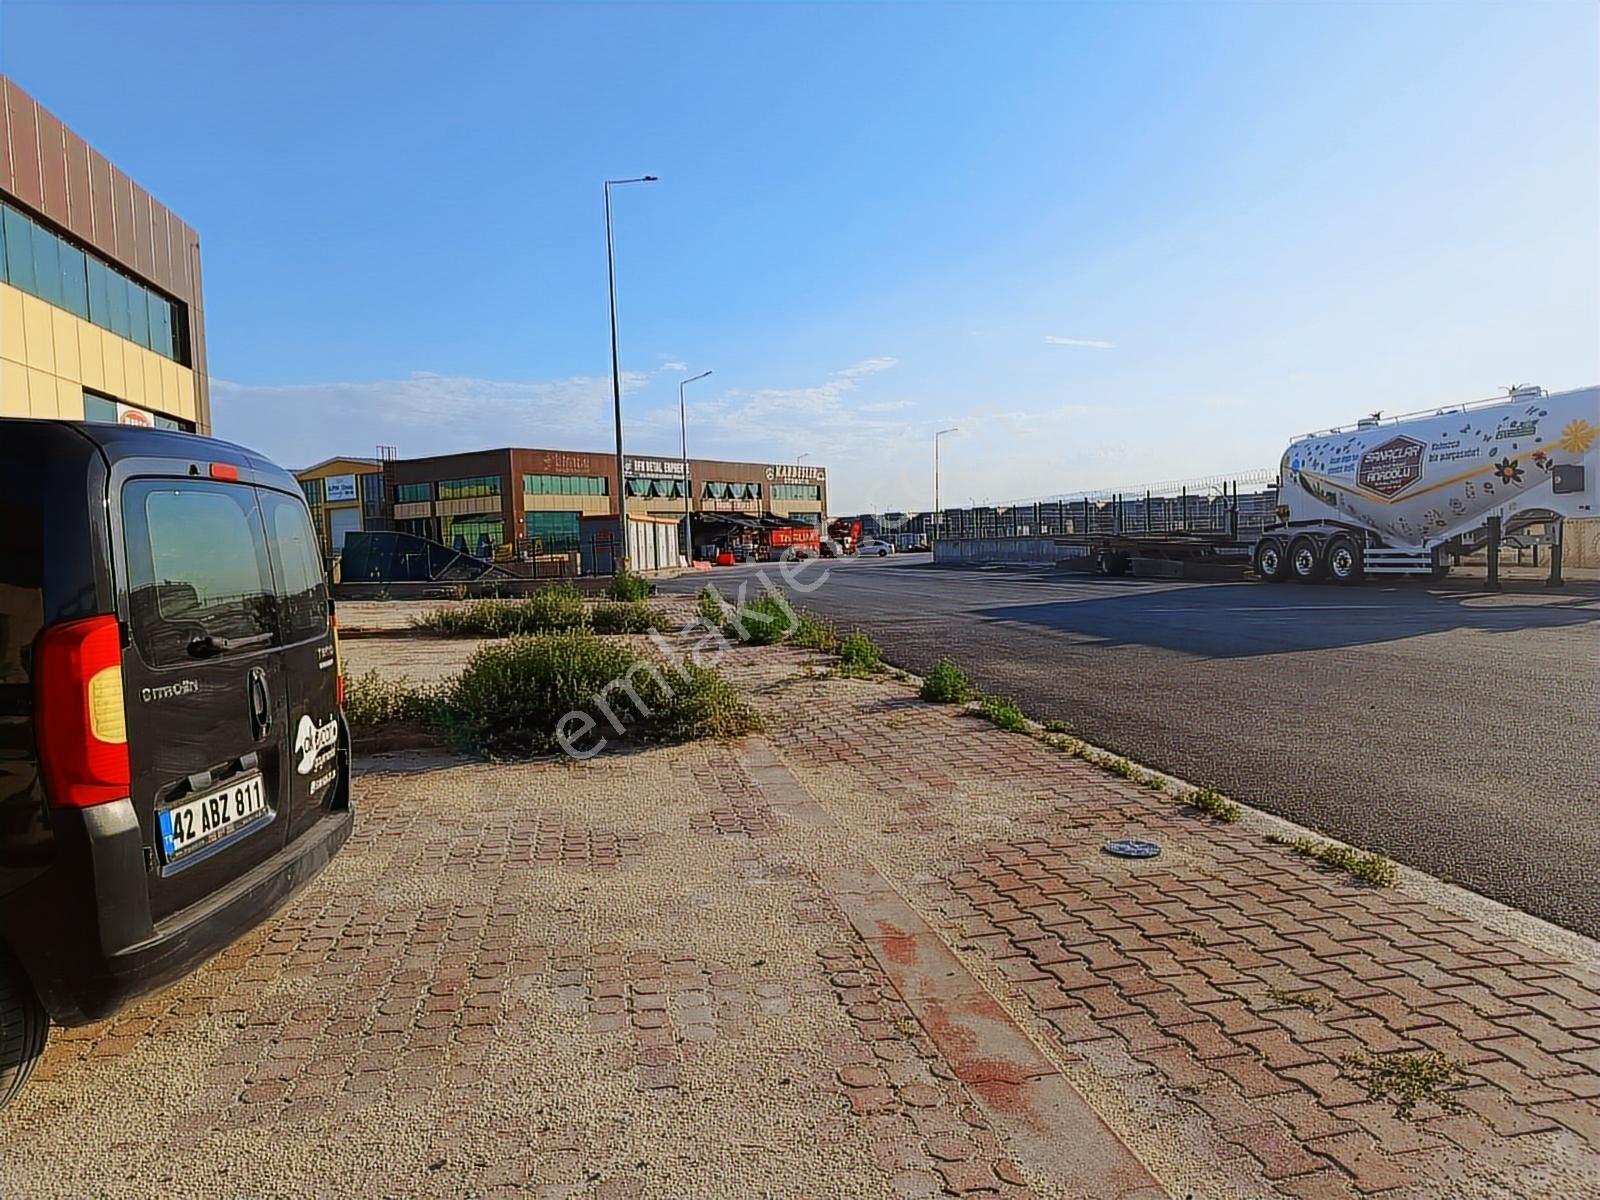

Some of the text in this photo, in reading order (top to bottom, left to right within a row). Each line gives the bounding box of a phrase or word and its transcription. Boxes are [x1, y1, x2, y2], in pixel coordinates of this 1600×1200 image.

[173, 808, 196, 843] 42
[201, 793, 231, 833] ABZ
[235, 781, 261, 817] 811
